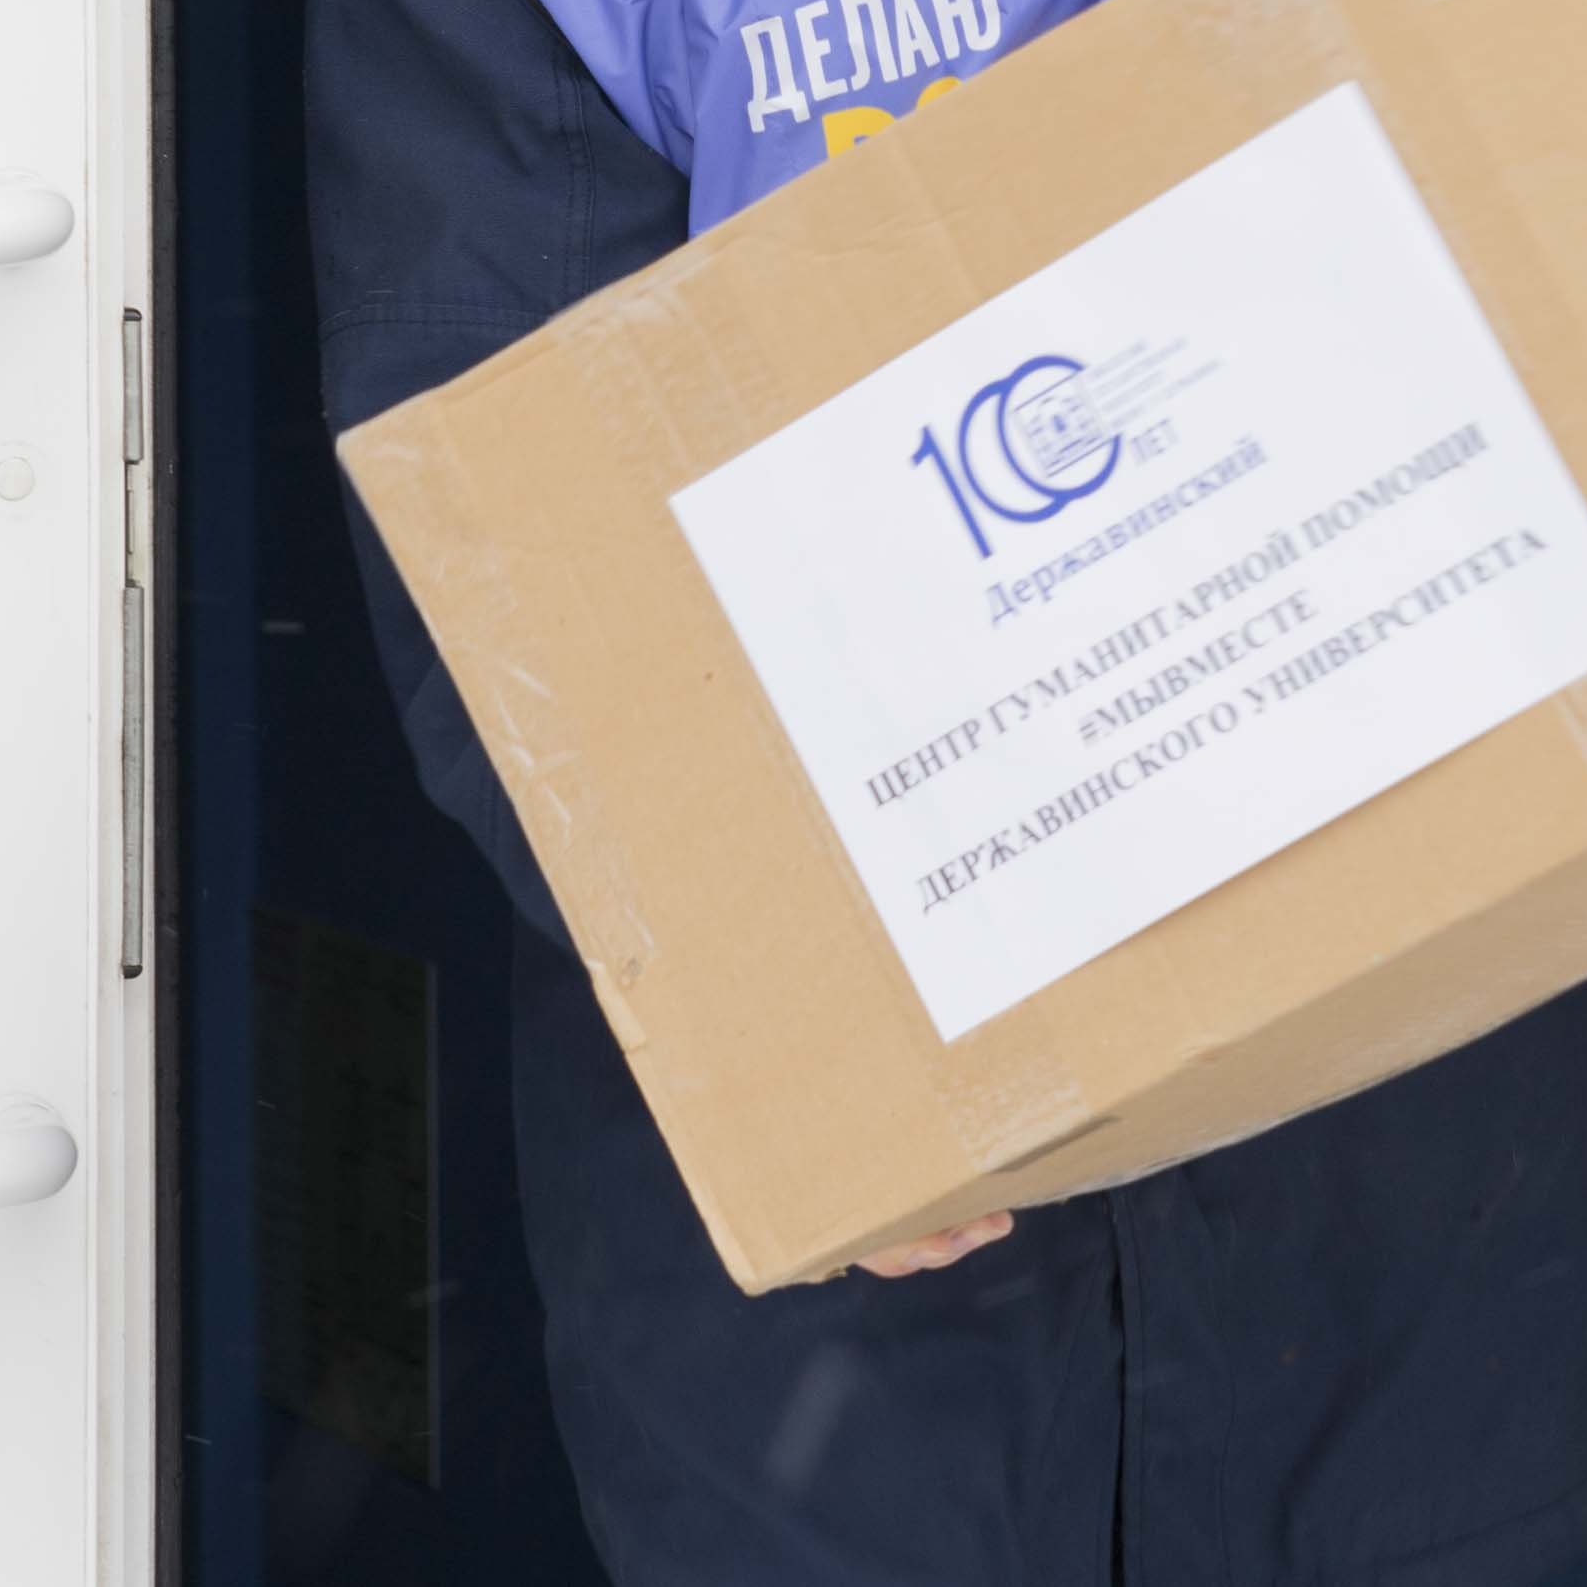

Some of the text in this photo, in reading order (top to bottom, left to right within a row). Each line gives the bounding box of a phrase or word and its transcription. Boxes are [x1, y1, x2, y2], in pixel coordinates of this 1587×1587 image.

[865, 421, 1489, 807] ЦЕНТР ГУМАНИТАРНОЙ ПОМОЩИ
[914, 528, 1548, 914] ДЕРЖАВИНСКОГО УНИВЕРСИТЕТА
[985, 433, 1268, 627] Державинский
